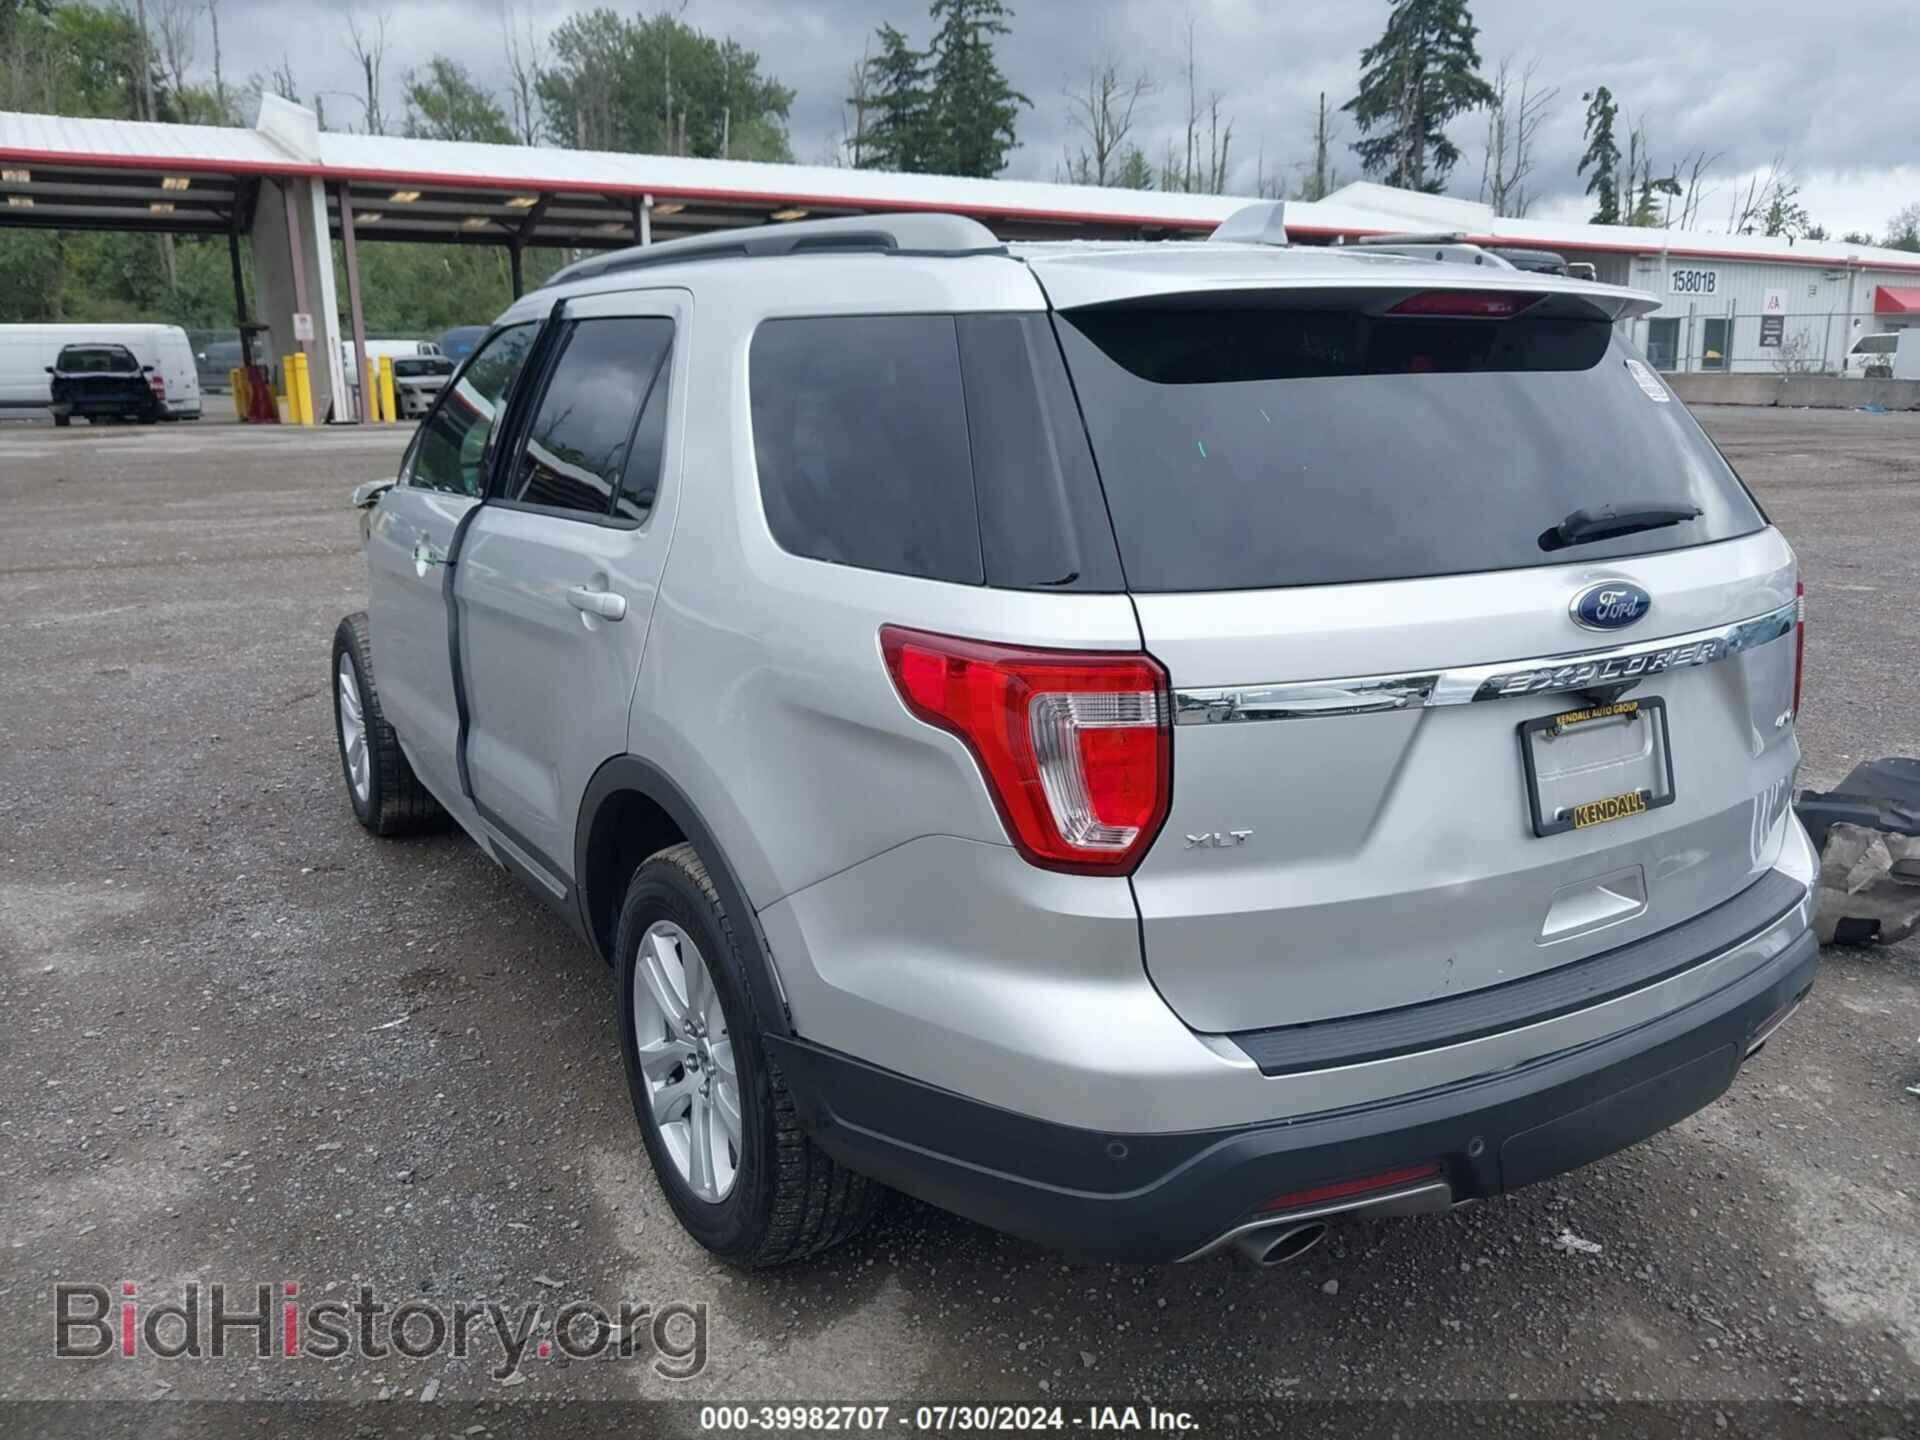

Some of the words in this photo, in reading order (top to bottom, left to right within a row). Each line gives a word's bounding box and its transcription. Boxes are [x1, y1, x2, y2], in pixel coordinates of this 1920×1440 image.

[1672, 270, 1716, 293] 15801B
[1596, 590, 1639, 620] Ford
[1498, 641, 1718, 694] EXPLORER
[1557, 710, 1591, 726] KENDALL
[1591, 706, 1612, 718] AUTO
[1613, 702, 1638, 714] GROUP
[1575, 791, 1646, 827] KENDALL
[1184, 829, 1254, 848] XLT
